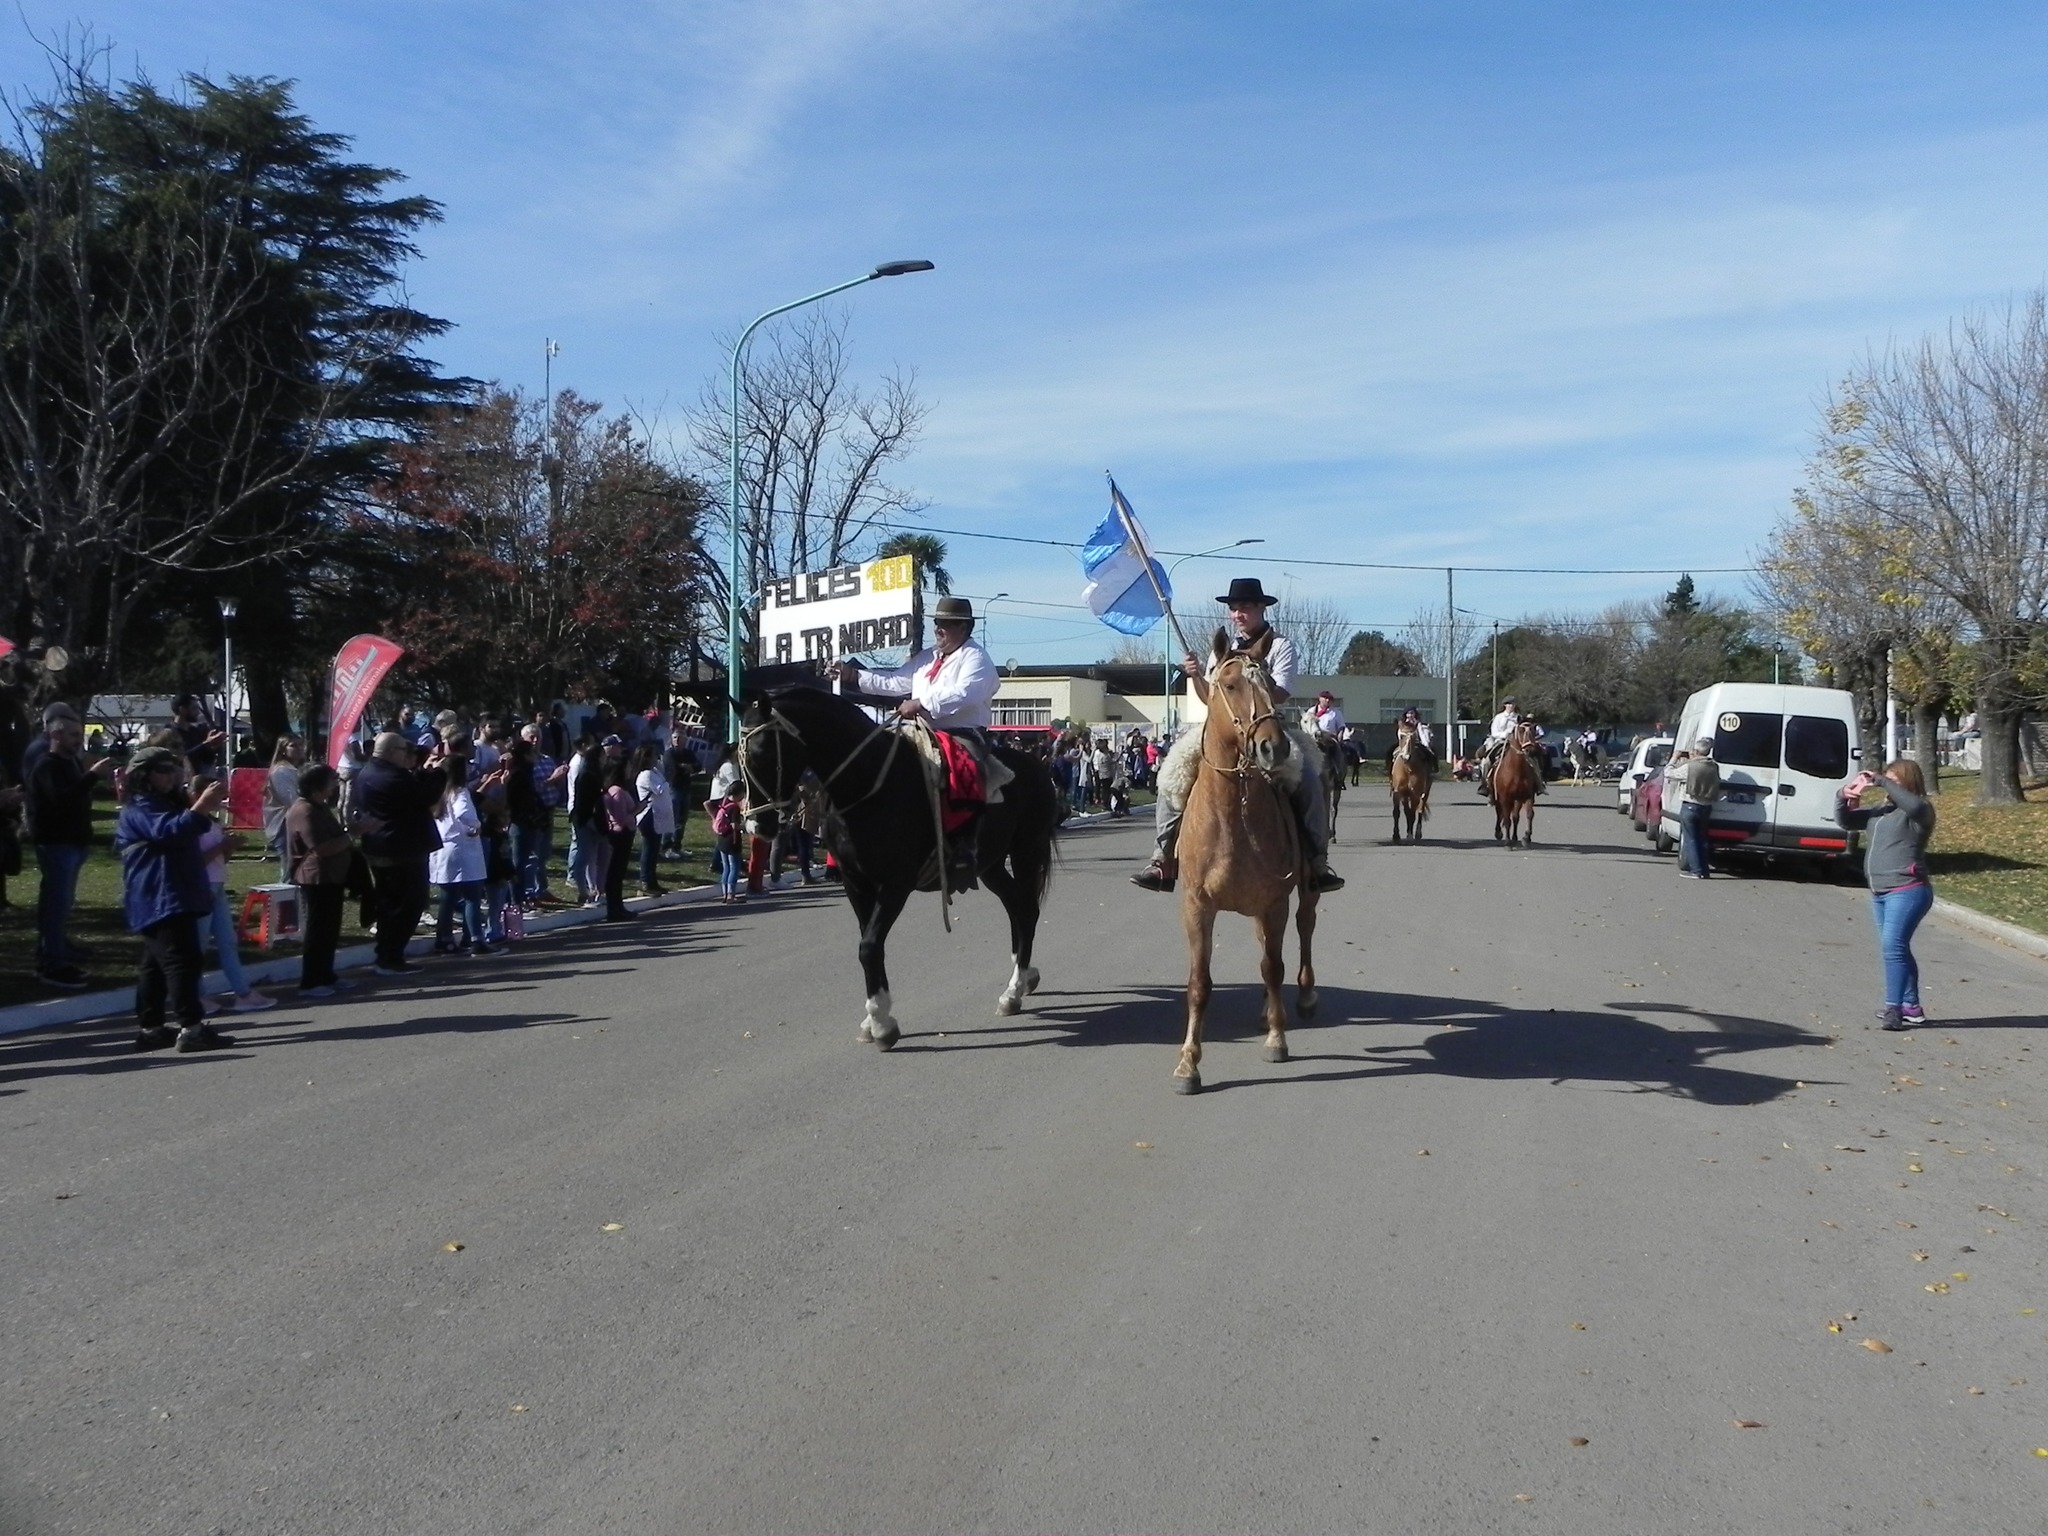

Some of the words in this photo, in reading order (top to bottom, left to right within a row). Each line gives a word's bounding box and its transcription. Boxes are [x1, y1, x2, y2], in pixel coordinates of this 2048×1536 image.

[760, 566, 861, 610] FELICES
[866, 556, 912, 592] 100
[759, 632, 792, 667] LA
[343, 697, 364, 730] General
[362, 661, 388, 694] Arenales
[1722, 717, 1738, 728] 110
